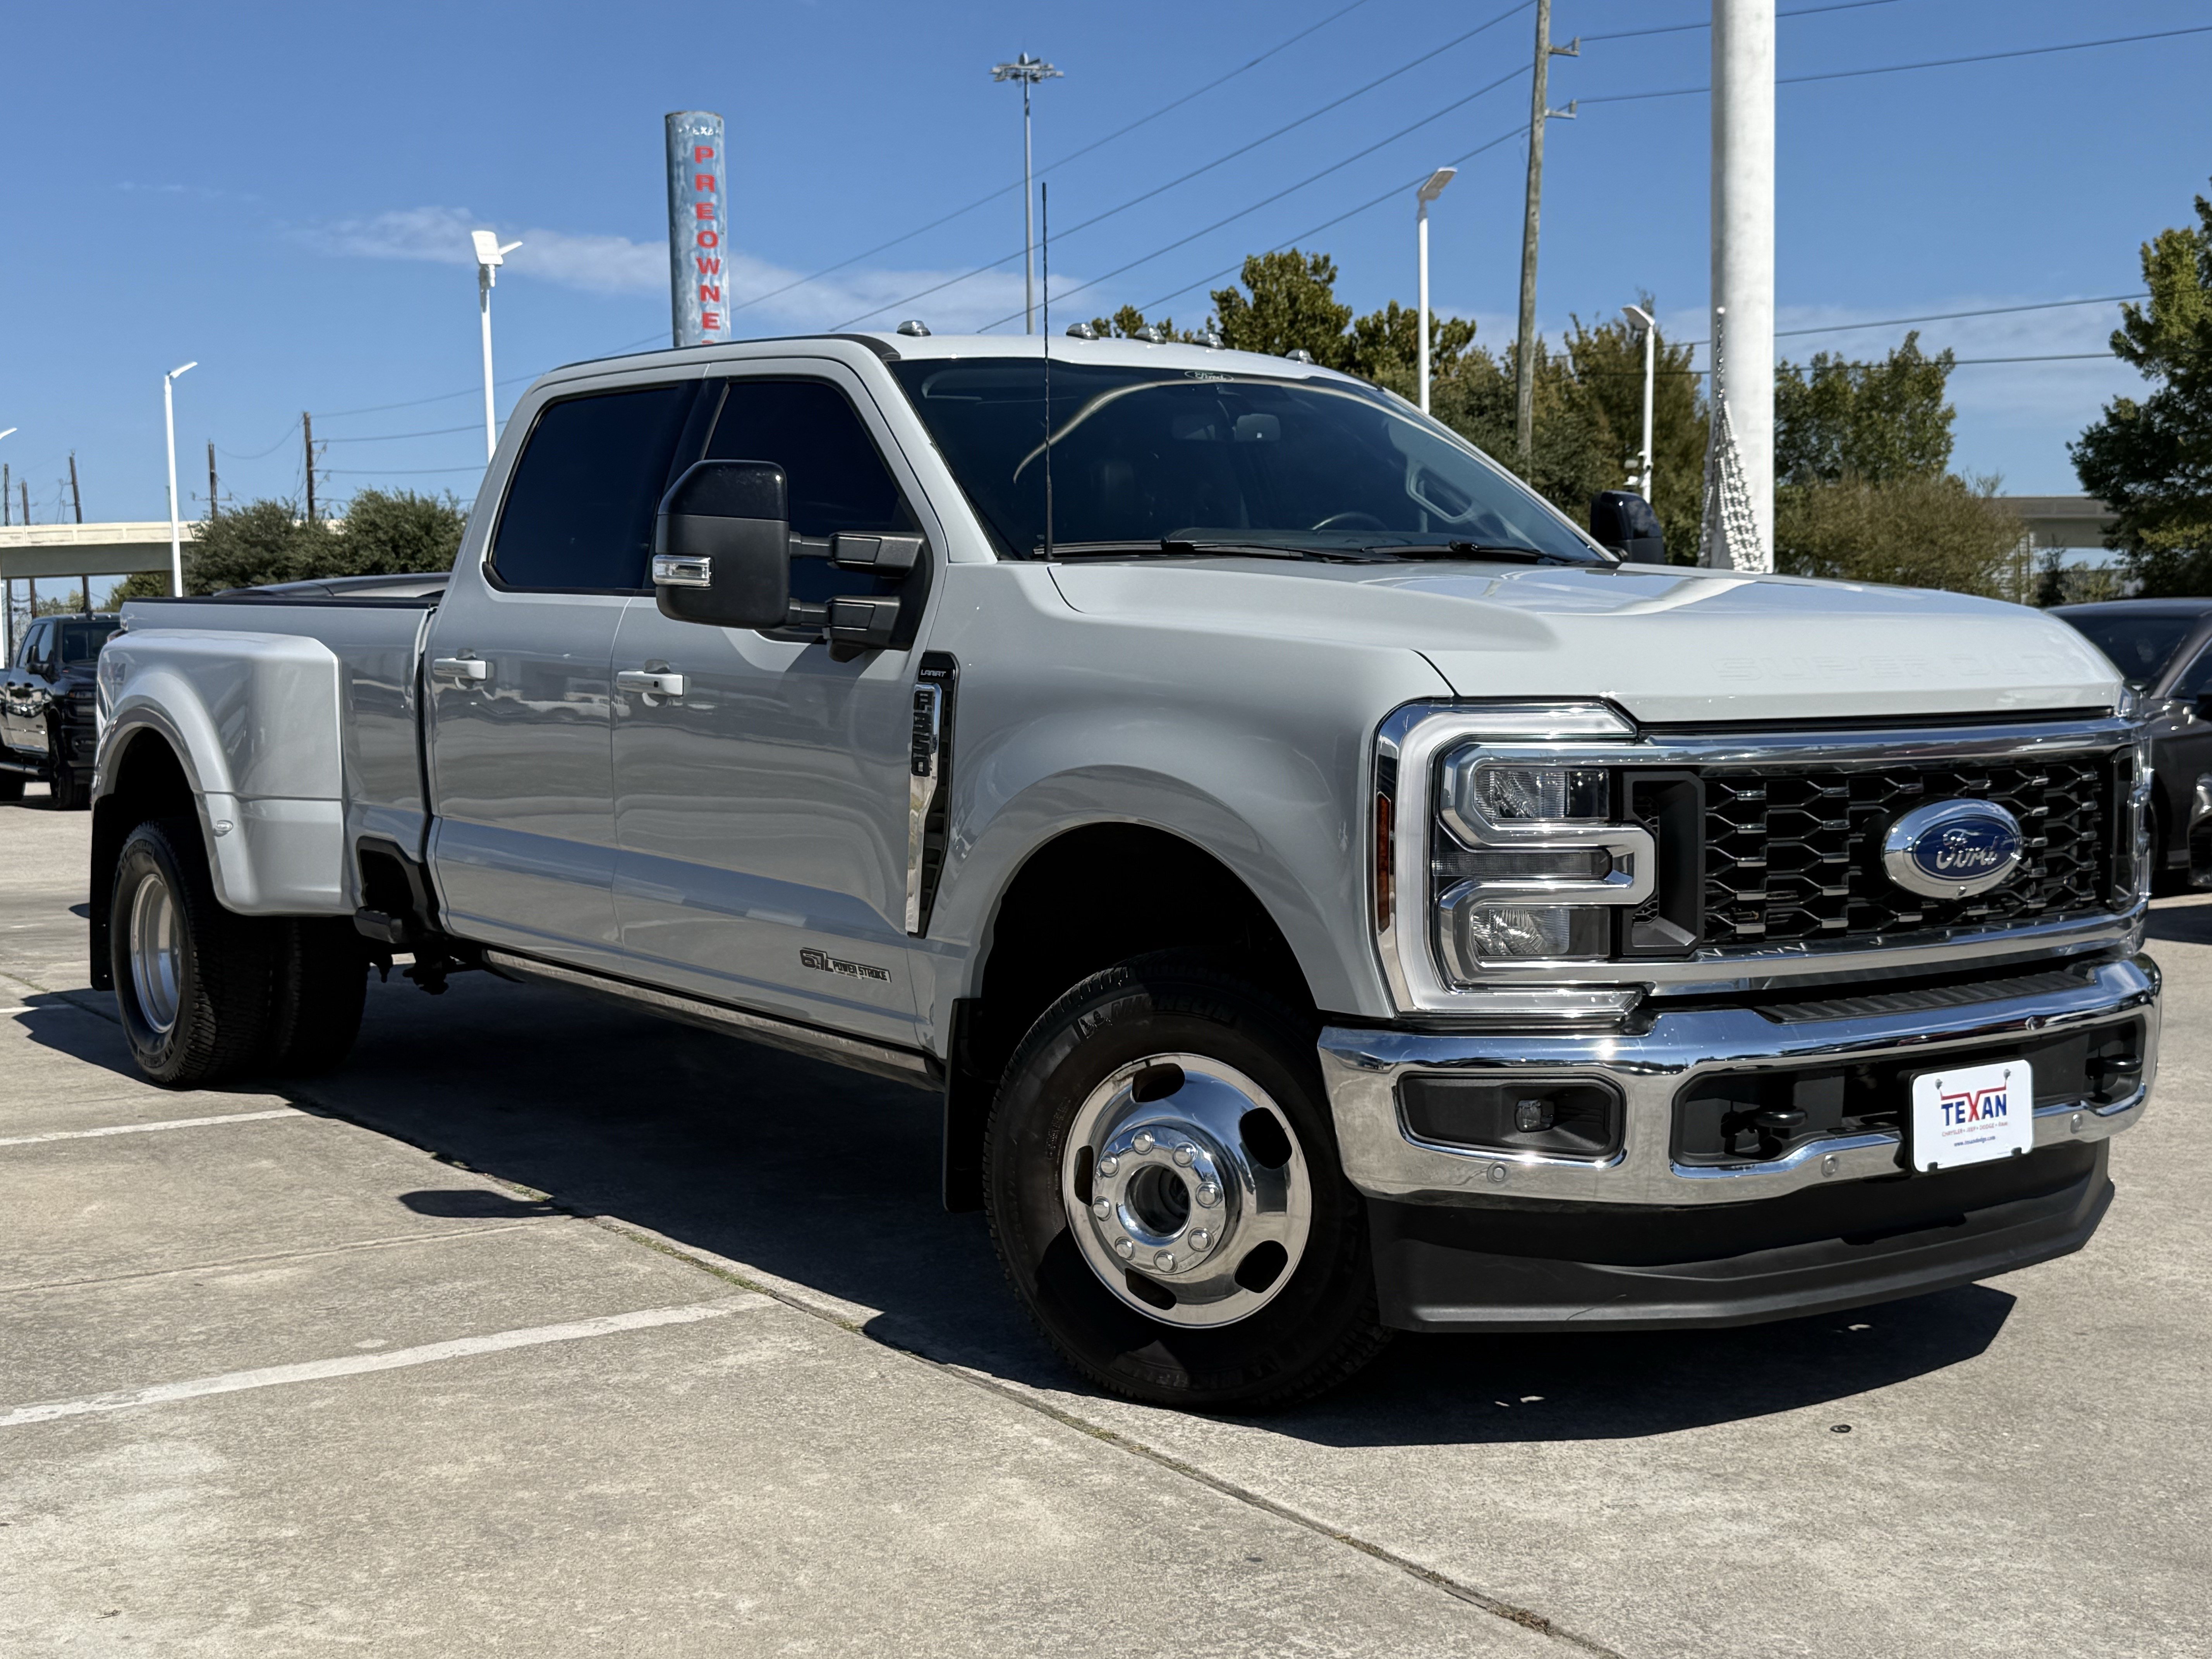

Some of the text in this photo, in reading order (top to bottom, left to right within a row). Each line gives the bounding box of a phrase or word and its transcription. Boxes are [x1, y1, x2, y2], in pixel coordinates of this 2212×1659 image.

[694, 146, 721, 344] PREOWNE
[1936, 828, 1999, 870] Ford
[858, 966, 888, 981] STROKE
[1941, 1087, 2007, 1127] TEXAN
[1979, 1122, 1994, 1130] DODGE
